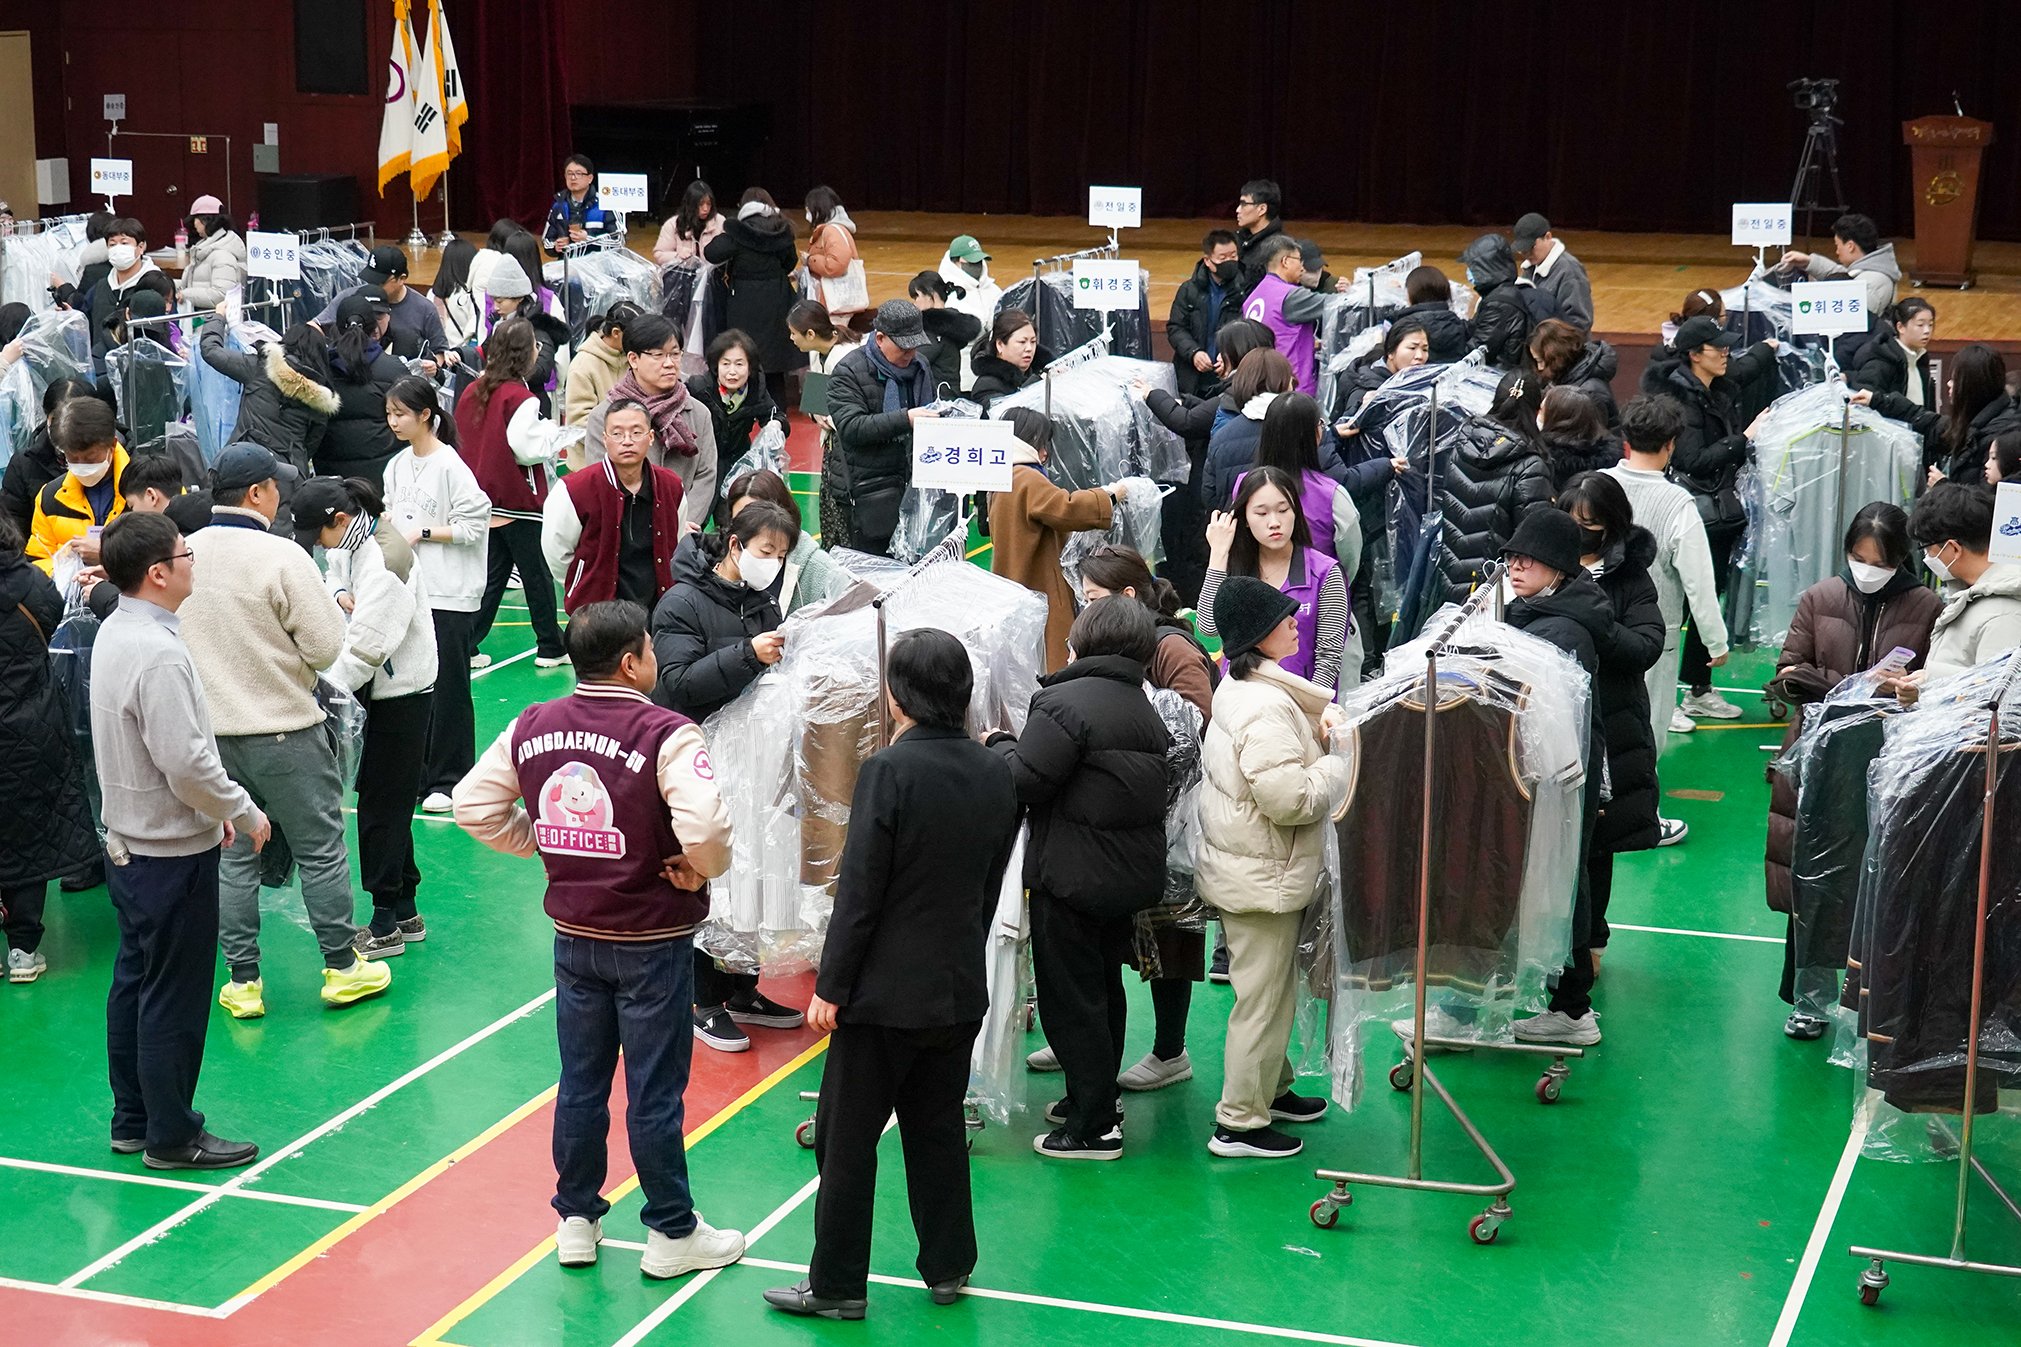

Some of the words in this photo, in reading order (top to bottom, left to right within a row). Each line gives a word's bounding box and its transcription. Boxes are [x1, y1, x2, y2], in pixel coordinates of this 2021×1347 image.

[103, 171, 130, 182] 동대부중
[612, 186, 645, 198] 동대부중
[1105, 201, 1137, 213] 전일중
[1750, 218, 1786, 230] 전일중
[263, 248, 295, 262] 숭인중
[1092, 278, 1133, 291] 휘경중
[1814, 299, 1861, 314] 휘경중
[945, 447, 1006, 466] 경희고
[518, 731, 647, 774] DONGDAEMUN-GU
[550, 828, 604, 849] OFFICE
